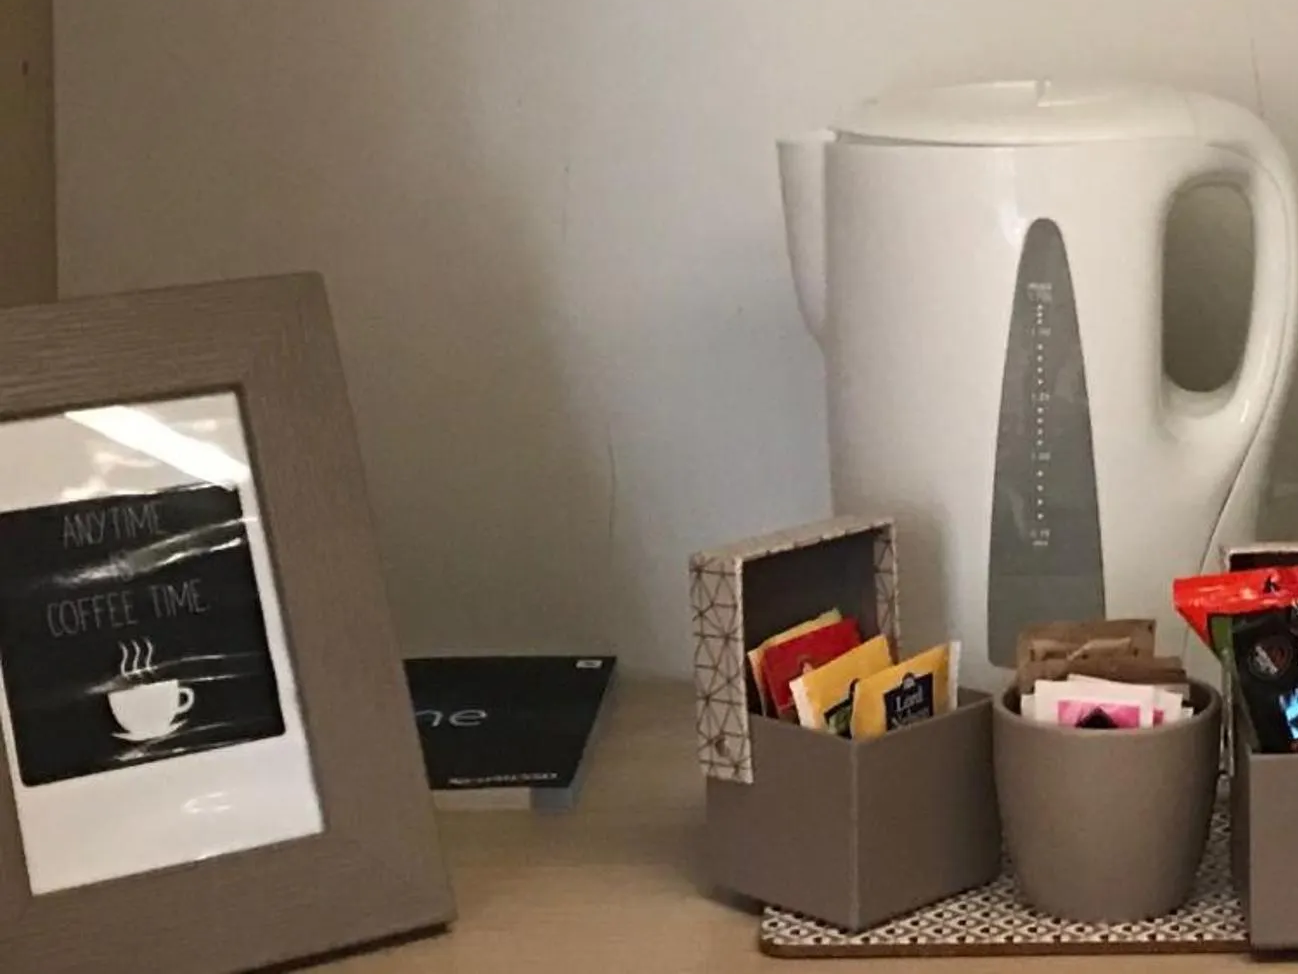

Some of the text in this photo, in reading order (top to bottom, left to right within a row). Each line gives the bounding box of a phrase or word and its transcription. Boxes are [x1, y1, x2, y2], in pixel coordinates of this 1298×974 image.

[63, 501, 163, 550] ANYTIME
[47, 579, 208, 638] COFFEE TIME
